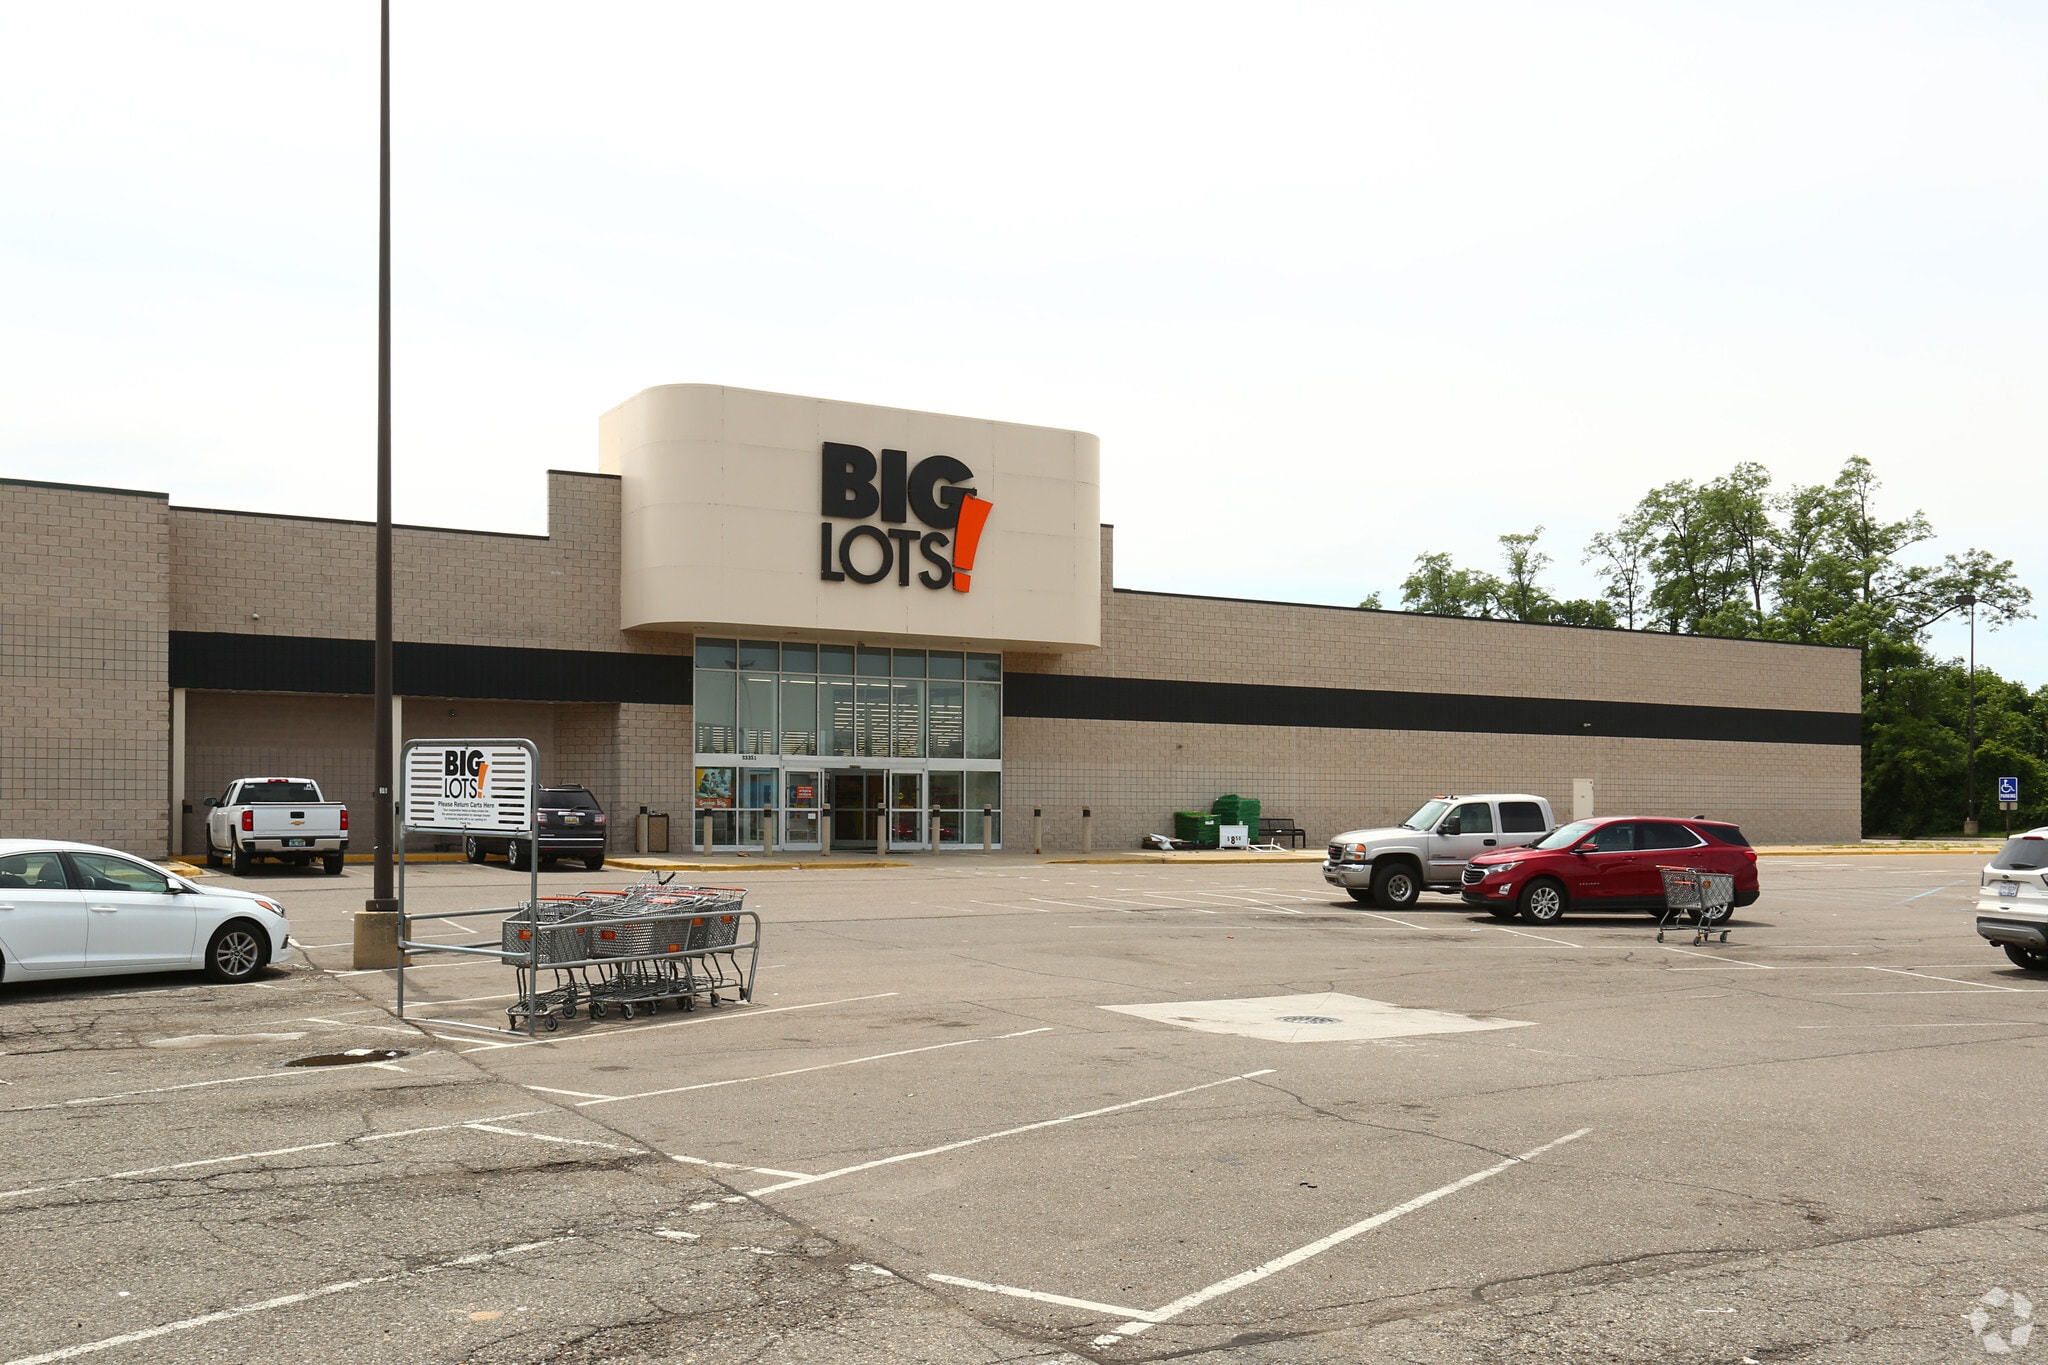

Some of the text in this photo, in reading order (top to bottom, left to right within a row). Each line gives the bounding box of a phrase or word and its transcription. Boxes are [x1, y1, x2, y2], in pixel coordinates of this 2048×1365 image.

[821, 441, 977, 529] BIG
[821, 494, 993, 593] LOTS!
[445, 750, 485, 777] BIG
[445, 763, 488, 798] LOTS!
